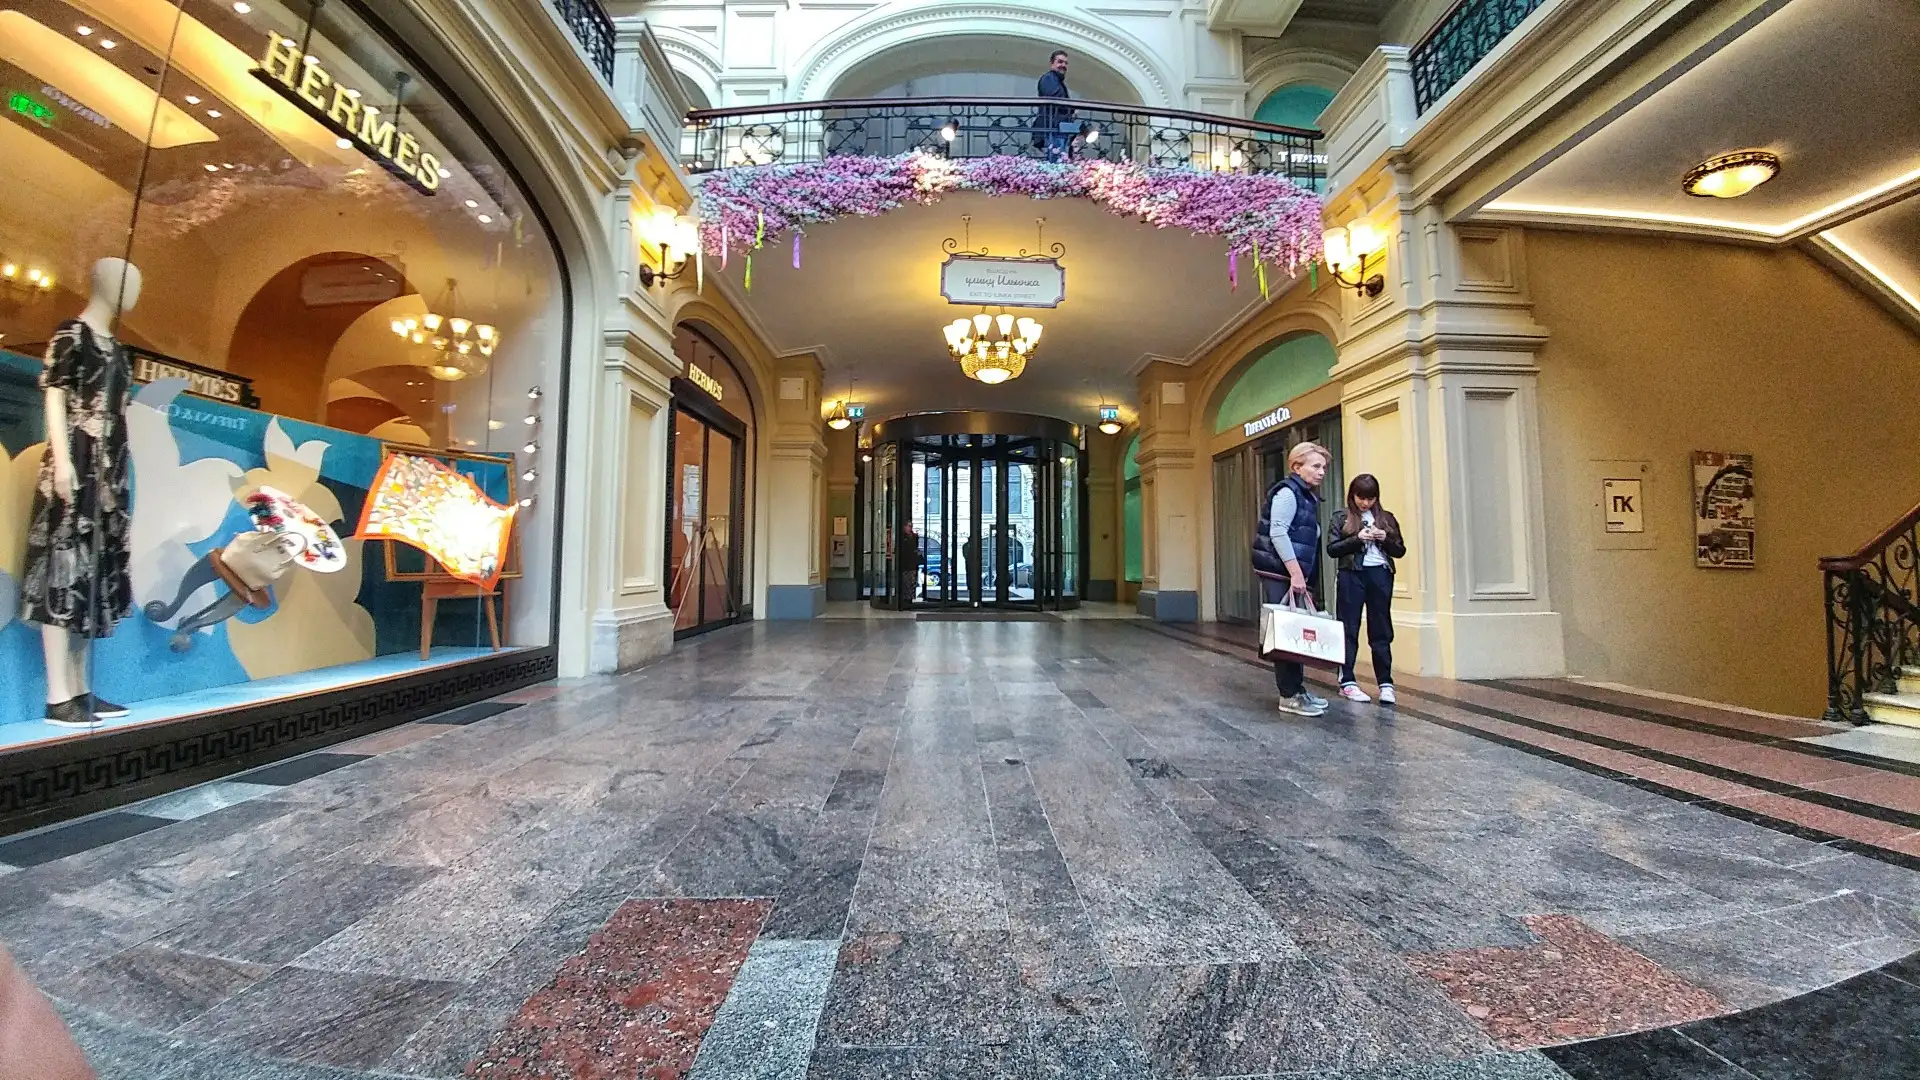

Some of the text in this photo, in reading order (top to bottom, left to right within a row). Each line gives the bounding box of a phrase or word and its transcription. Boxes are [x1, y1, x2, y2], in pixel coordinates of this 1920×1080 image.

[965, 275, 1041, 287] улицу Ильинка
[1613, 495, 1635, 513] ПК
